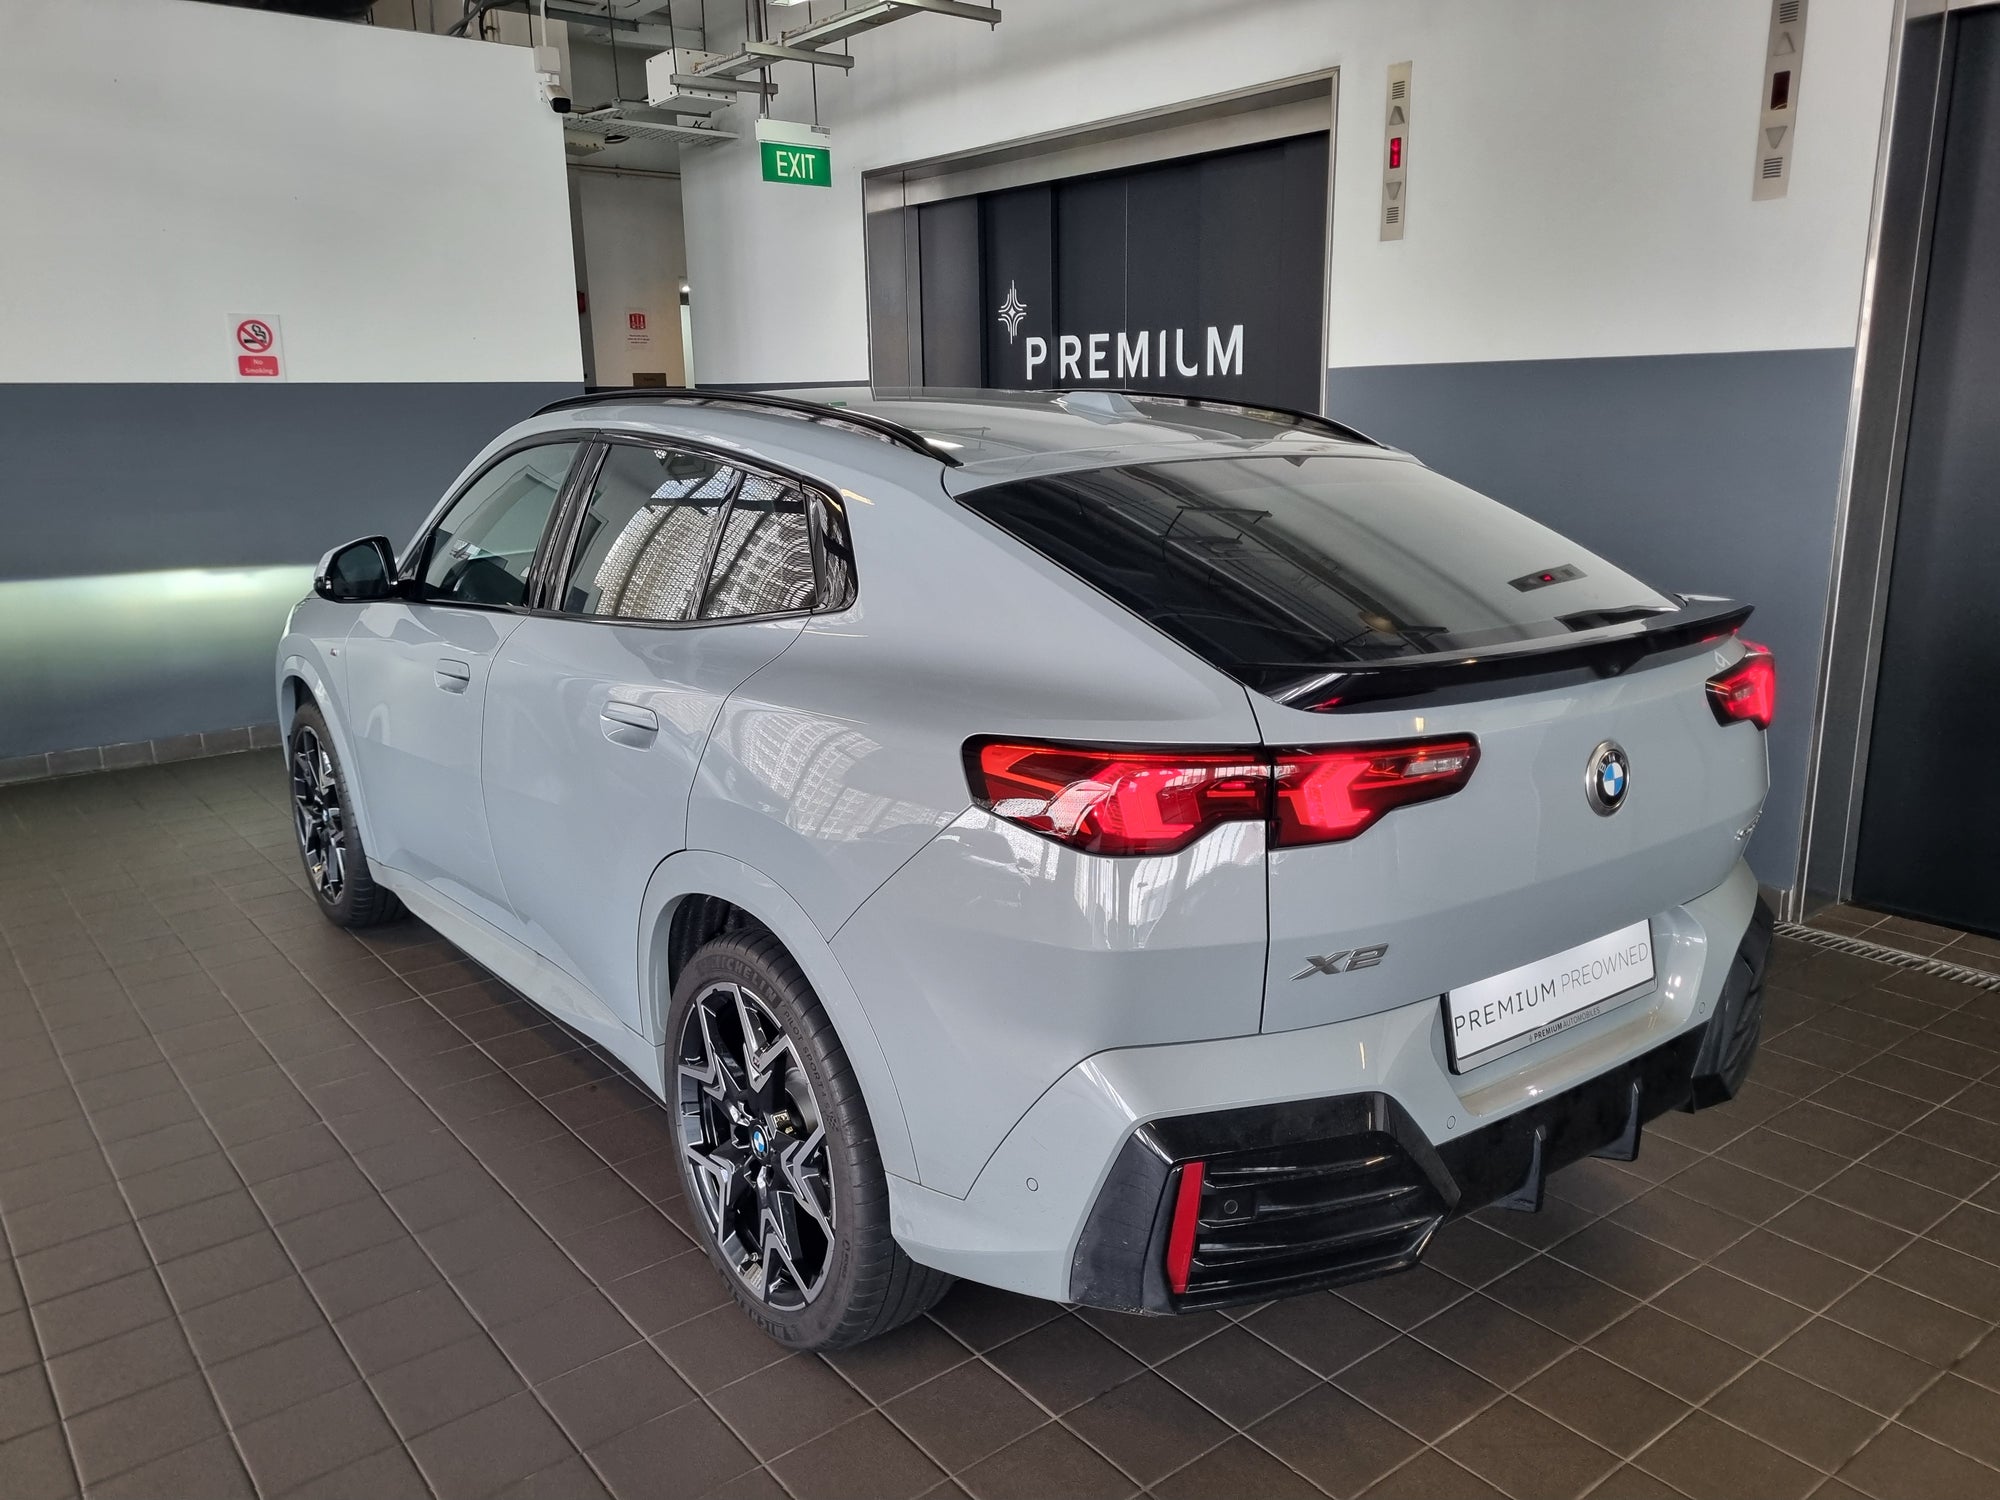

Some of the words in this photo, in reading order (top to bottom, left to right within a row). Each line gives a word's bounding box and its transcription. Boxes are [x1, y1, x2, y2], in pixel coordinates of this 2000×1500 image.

[776, 150, 816, 179] EXIT
[252, 358, 264, 366] No
[1026, 324, 1244, 380] PREMIUM
[244, 367, 274, 376] Smoking
[1288, 942, 1390, 981] X2
[1454, 979, 1557, 1037] PREMIUM
[1560, 942, 1649, 992] PREOWNED
[784, 1010, 804, 1041] PILOT
[802, 1045, 825, 1087] SPORT
[1533, 1022, 1563, 1041] PREMIUM
